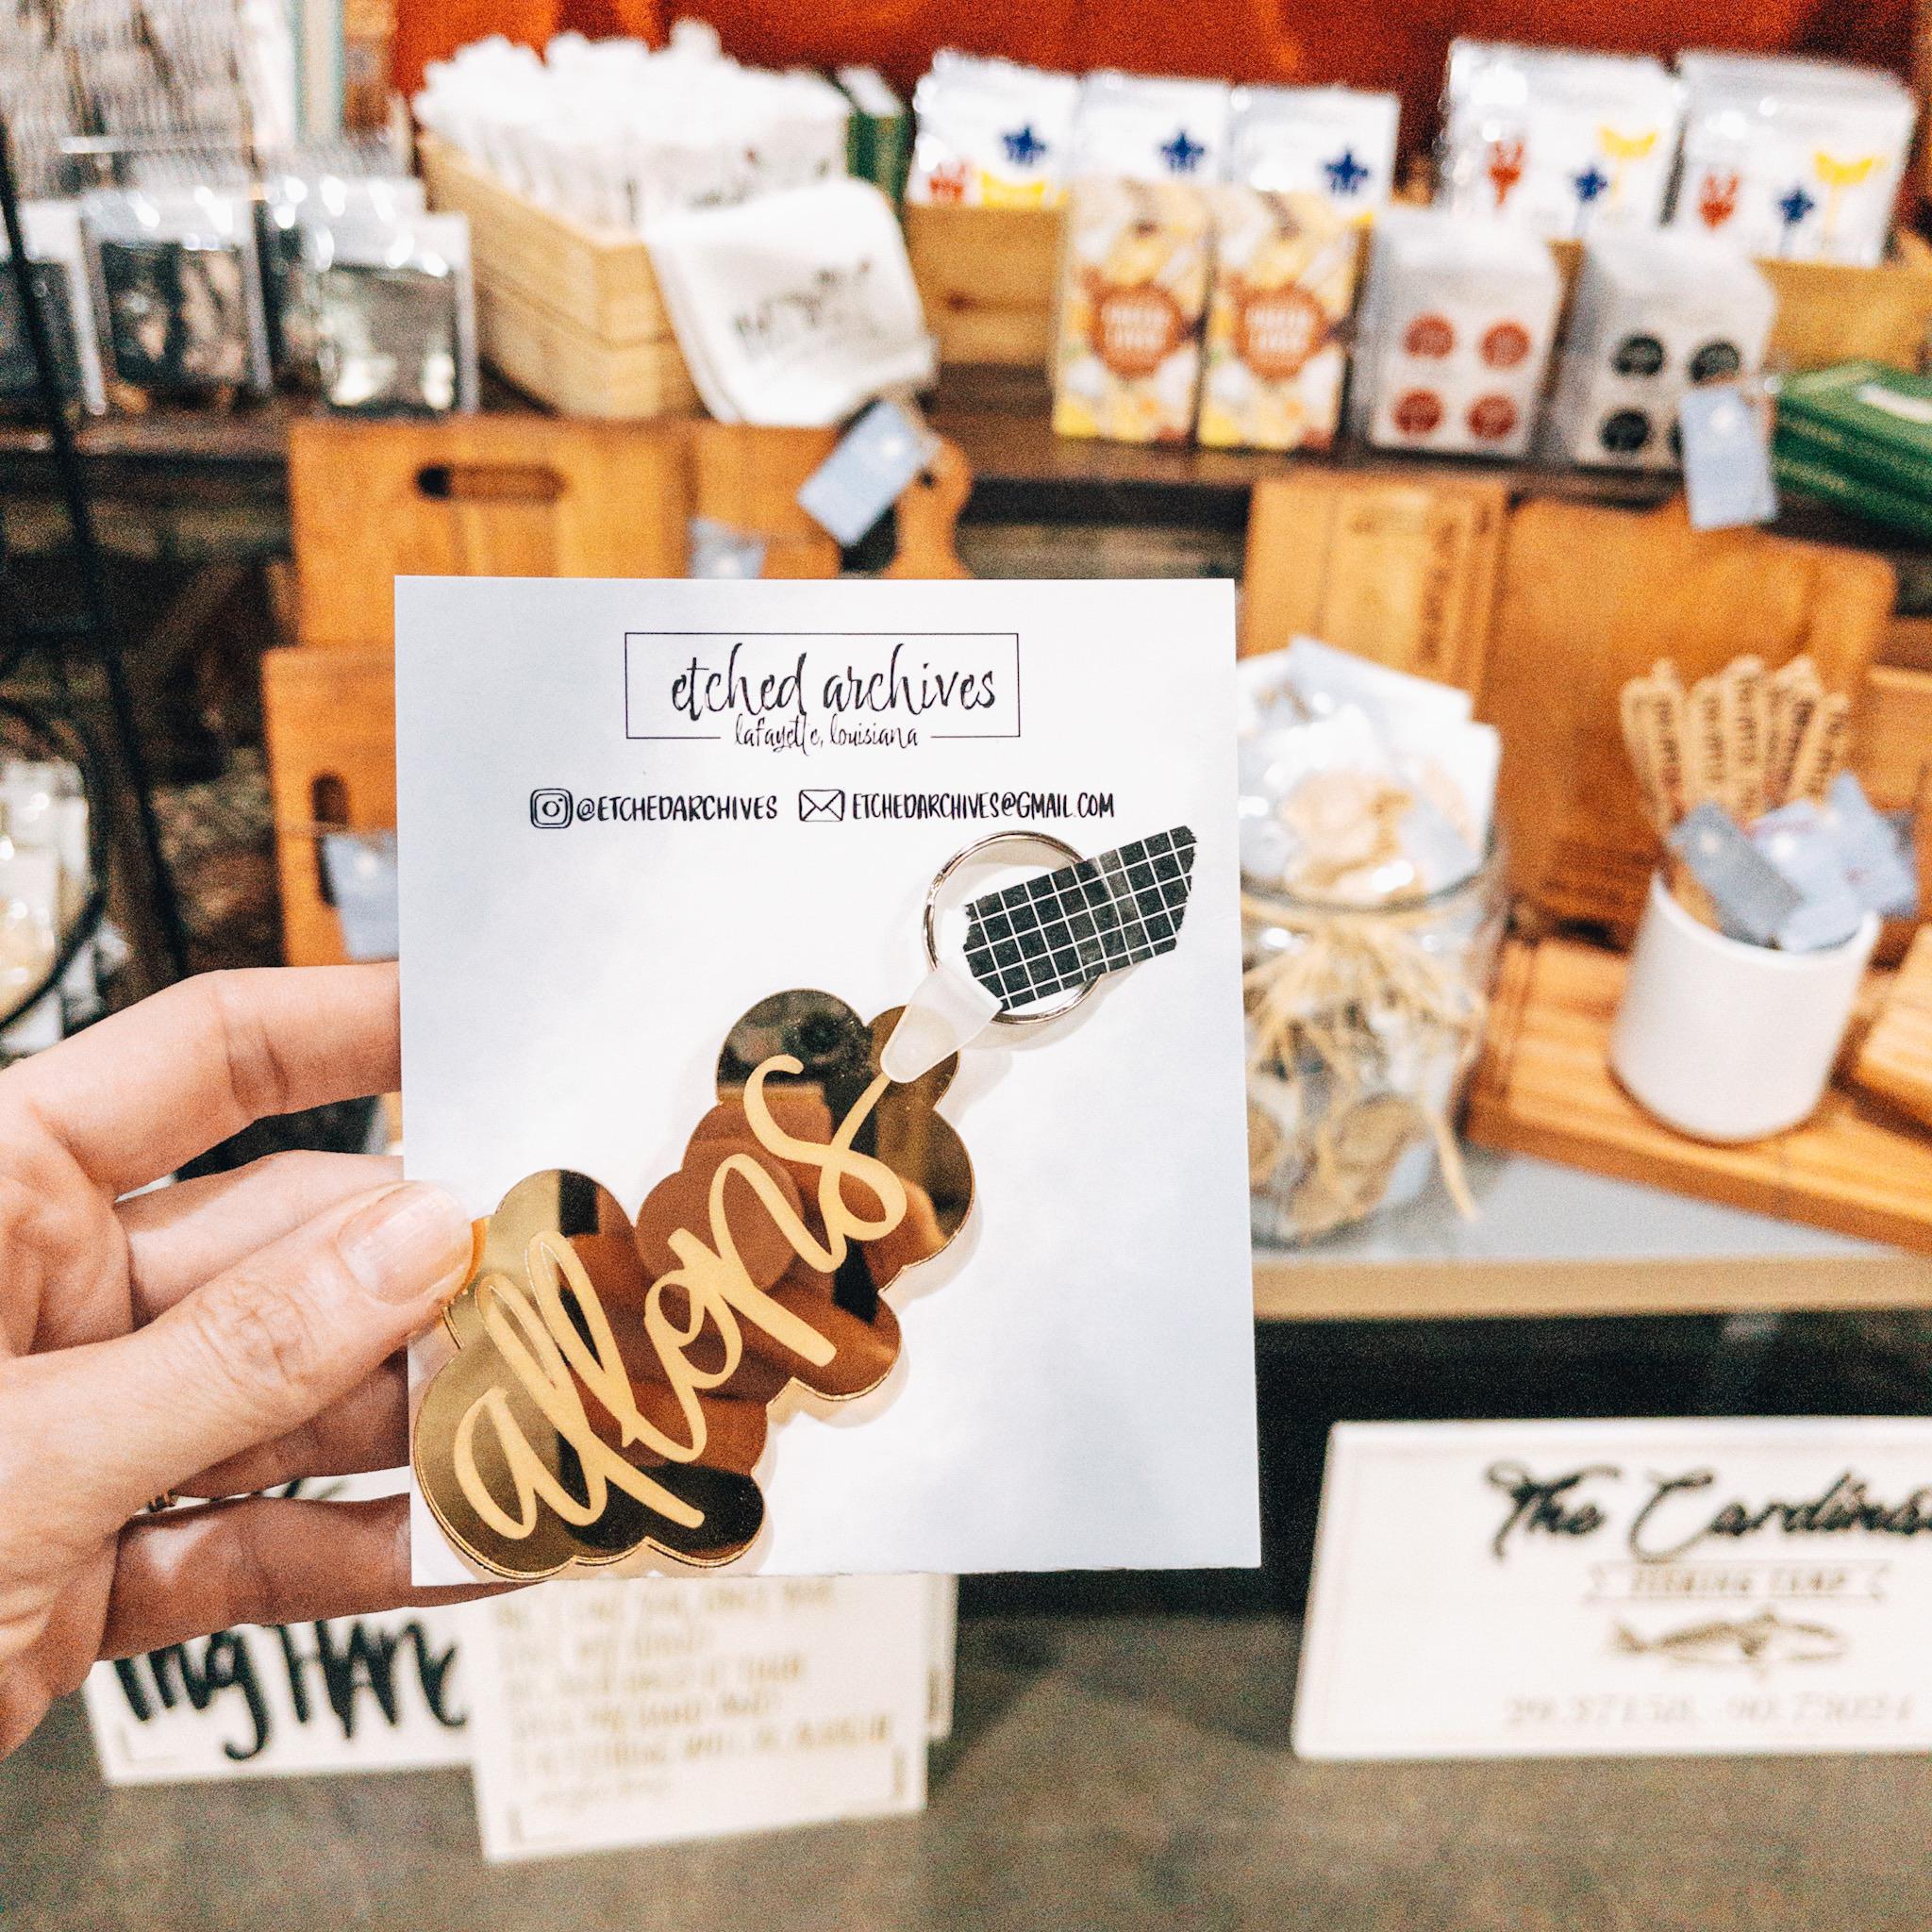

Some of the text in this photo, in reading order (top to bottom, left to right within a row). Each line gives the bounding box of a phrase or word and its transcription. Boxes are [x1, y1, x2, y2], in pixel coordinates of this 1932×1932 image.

[672, 642, 996, 721] etched archives
[735, 713, 918, 756] lafayette, louisiana
[576, 791, 1115, 823] @ETCHEDARCHIVES ETCHEDARCHIVES@GMAIL.COM
[454, 1055, 908, 1541] allons
[1485, 1460, 1623, 1561] The
